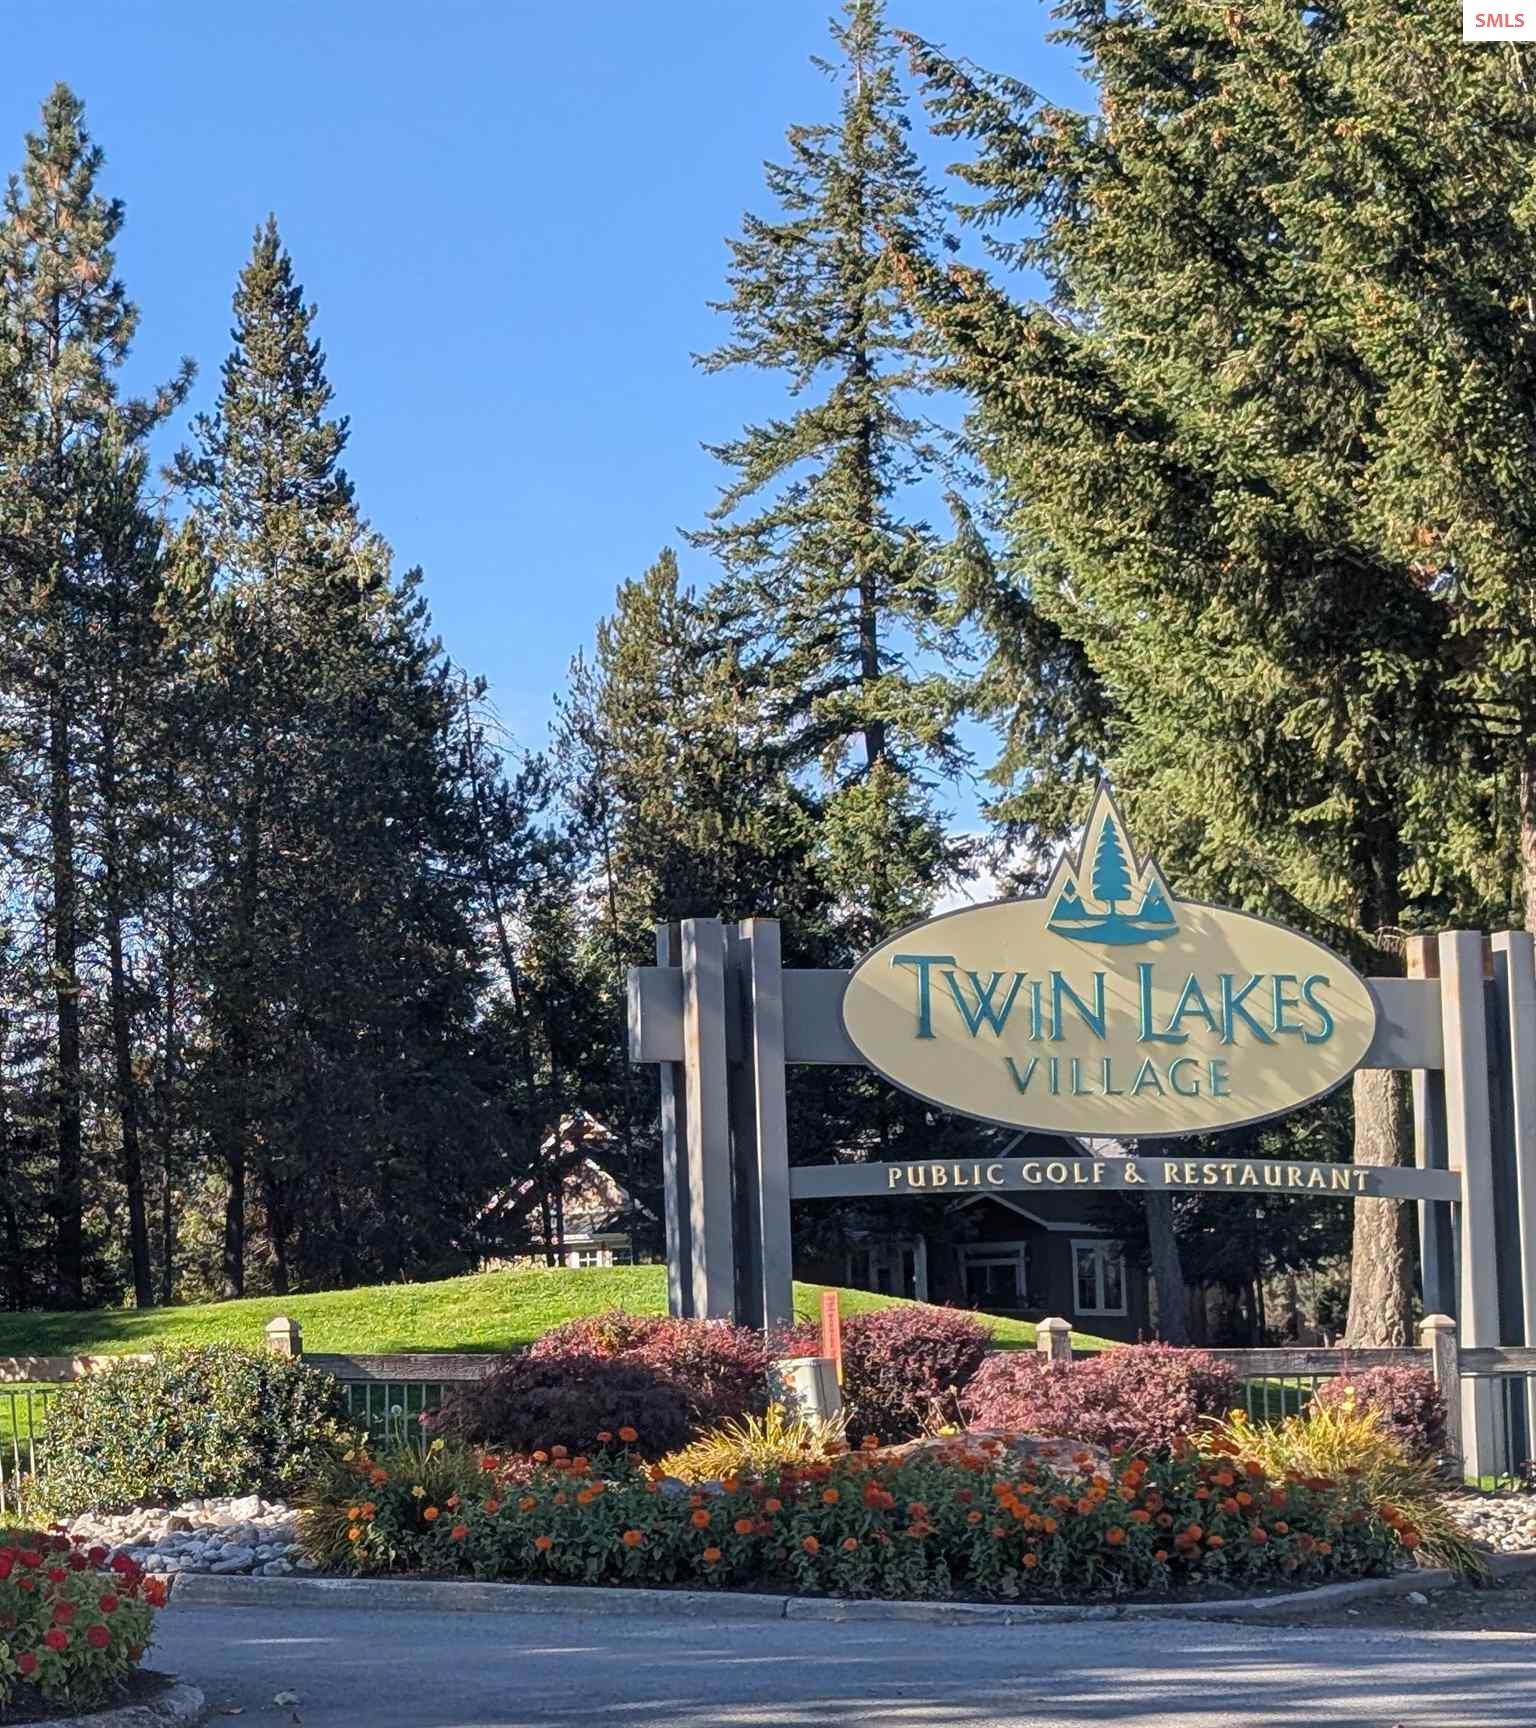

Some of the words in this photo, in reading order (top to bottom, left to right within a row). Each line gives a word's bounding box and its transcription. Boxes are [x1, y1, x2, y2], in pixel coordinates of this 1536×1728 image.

[1004, 1055, 1233, 1098] VILLAGE
[888, 1163, 1006, 1189] PUBLIC
[1021, 1161, 1107, 1185] GOLF
[1123, 1163, 1145, 1184] &
[1163, 1162, 1371, 1193] RESTAURANT
